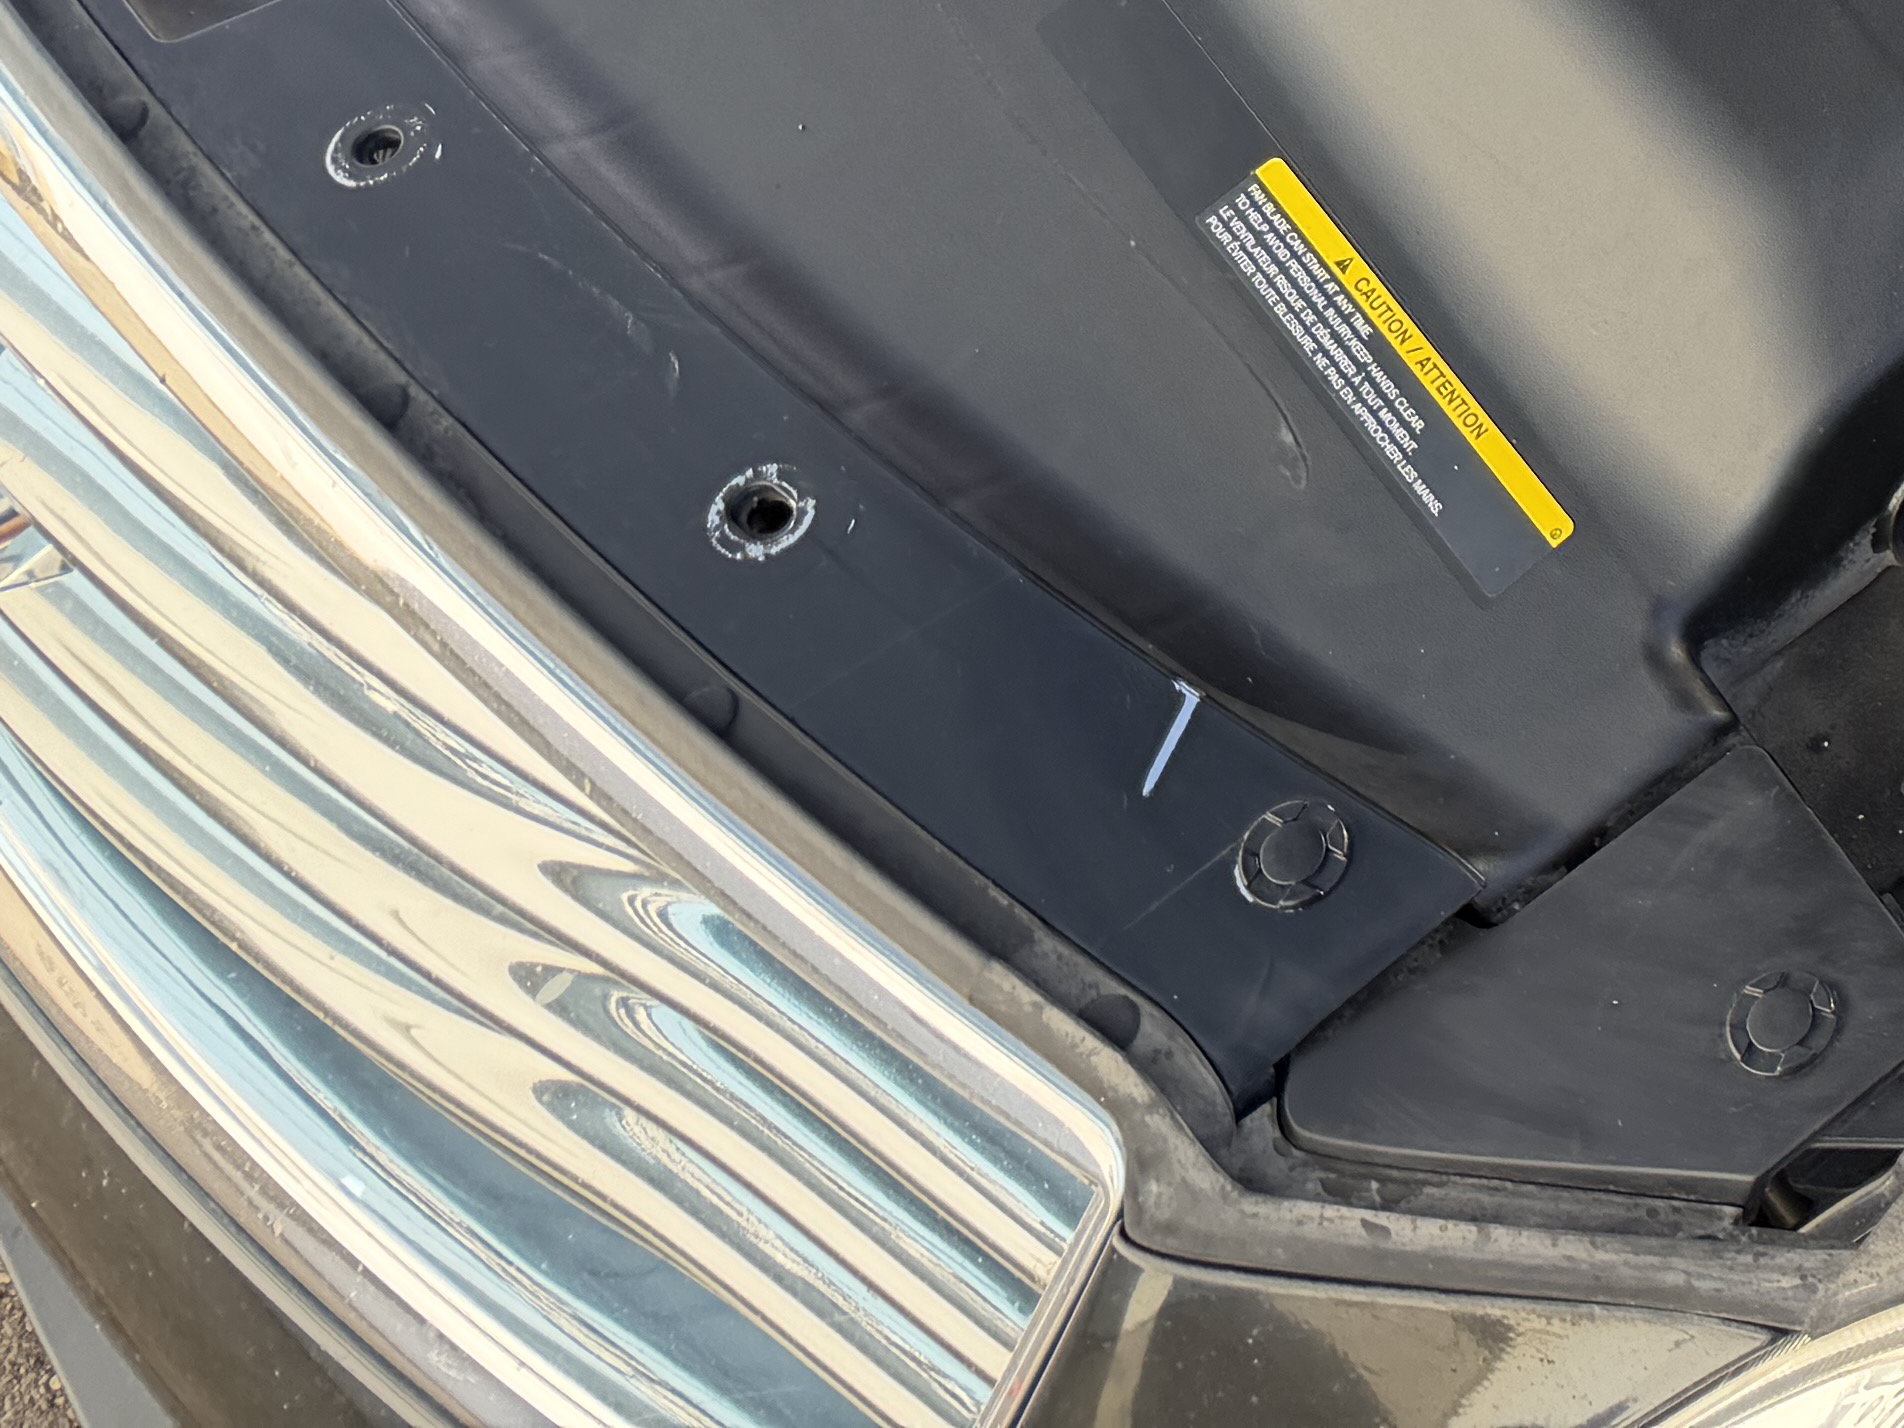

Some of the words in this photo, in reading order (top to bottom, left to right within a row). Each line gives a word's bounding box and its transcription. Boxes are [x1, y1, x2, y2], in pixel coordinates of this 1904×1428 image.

[1205, 215, 1233, 247] POUR
[1226, 240, 1256, 278] ÉVITER
[1251, 271, 1281, 308] TOUTE
[1312, 352, 1331, 372] NE
[1323, 367, 1346, 391] PAS
[1339, 386, 1357, 406] EN
[1351, 402, 1403, 466] APPROCHER
[1396, 459, 1419, 484] LES
[1412, 478, 1444, 518] MAINS.
[1218, 205, 1235, 222] LE
[1229, 219, 1281, 279] VENTILATEUR
[1273, 274, 1306, 314] RISQUE
[1300, 308, 1319, 327] DE
[1311, 324, 1357, 379] DÉMARRER
[1358, 380, 1385, 411] TOUT
[1377, 407, 1420, 457] MOMENT.
[1234, 192, 1251, 211] TO
[1245, 207, 1270, 233] HELP
[1263, 232, 1291, 261] AVOID
[1285, 258, 1329, 312] PERSONAL
[1367, 362, 1400, 401] HANDS
[1393, 397, 1426, 435] CLEAR.
[1247, 183, 1268, 207] FAN
[1262, 200, 1292, 236] BLADE
[1285, 232, 1308, 257] CAN
[1301, 251, 1331, 284] START
[1323, 279, 1341, 295] AT
[1333, 293, 1357, 317] ANY
[1354, 276, 1412, 346] CAUTION
[1405, 346, 1424, 355] /
[1415, 356, 1489, 441] ATTENTION
